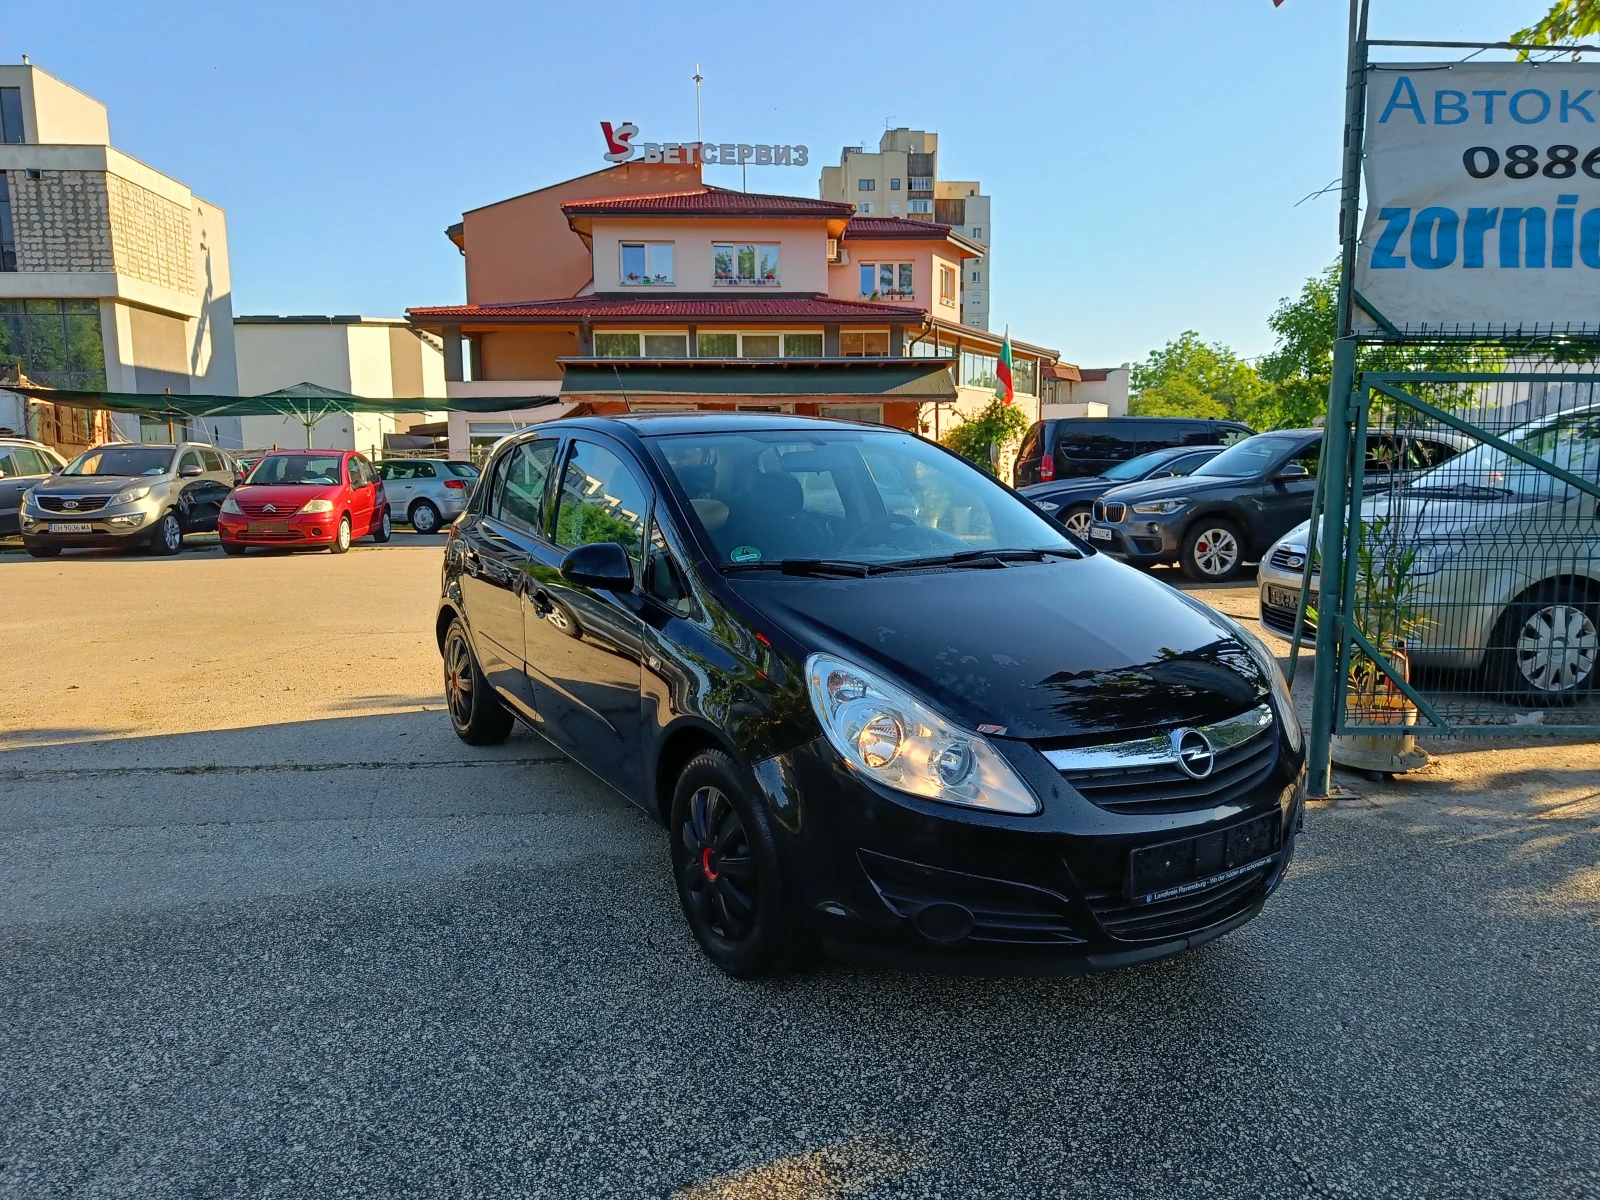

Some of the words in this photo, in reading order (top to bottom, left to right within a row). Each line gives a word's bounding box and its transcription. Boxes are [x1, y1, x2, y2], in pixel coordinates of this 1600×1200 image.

[1378, 76, 1600, 125] Авток
[644, 142, 809, 166] ВЕТСЕРВИЗ
[1178, 882, 1207, 894] Ravensburg
